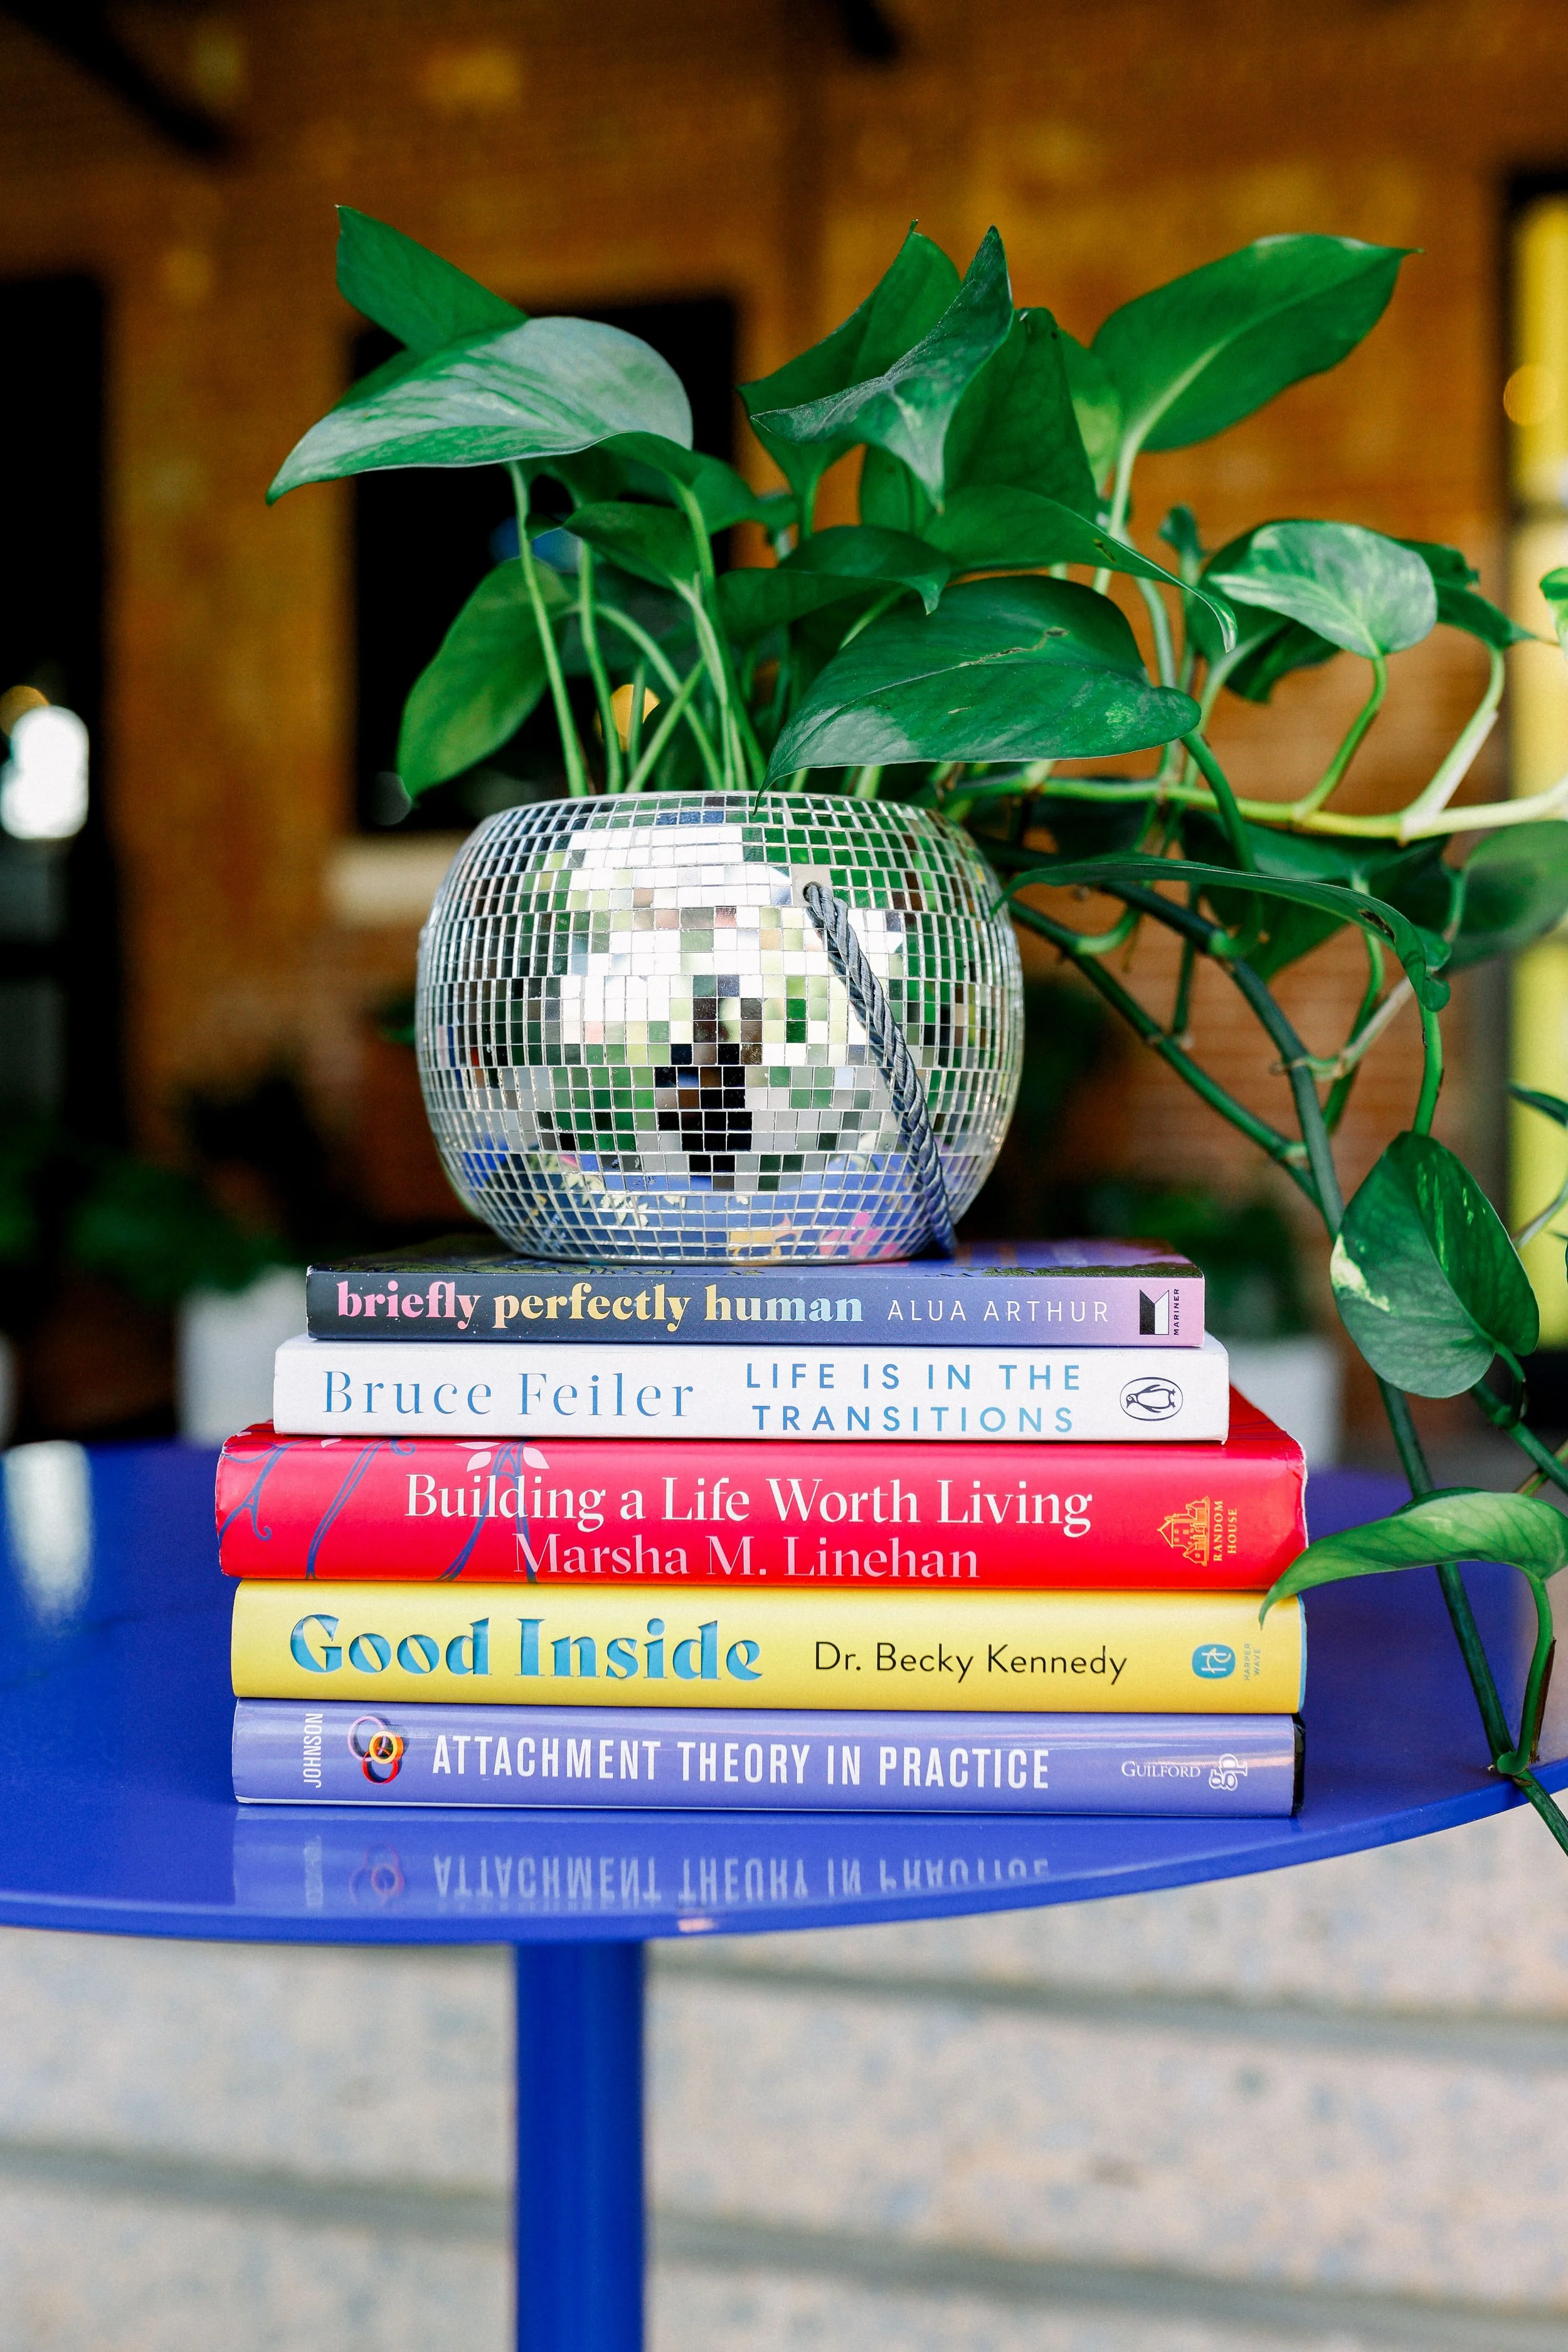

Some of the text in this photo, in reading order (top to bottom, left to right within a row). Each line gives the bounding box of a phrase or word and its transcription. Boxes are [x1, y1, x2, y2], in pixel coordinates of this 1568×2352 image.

[337, 1280, 864, 1332] briefly perfectly human
[887, 1300, 1109, 1322] ALUA ARTHUR
[322, 1372, 693, 1416] Bruce Feiler
[747, 1364, 1079, 1390] LIFE IS IN THE
[752, 1406, 1072, 1433] TRANSITIONS
[404, 1474, 1093, 1537] Building a Life Worth Living
[1213, 1500, 1223, 1562] RANDOM
[1227, 1508, 1237, 1554] HOUSE
[512, 1534, 978, 1577] Marsha M. Linehan
[290, 1613, 762, 1680] Good Inside
[816, 1641, 1126, 1685] Dr. Becky Kennedy
[303, 1713, 323, 1789] JOHNSON
[432, 1733, 1049, 1789] ATTACHMENT THEORY IN PRACTICE
